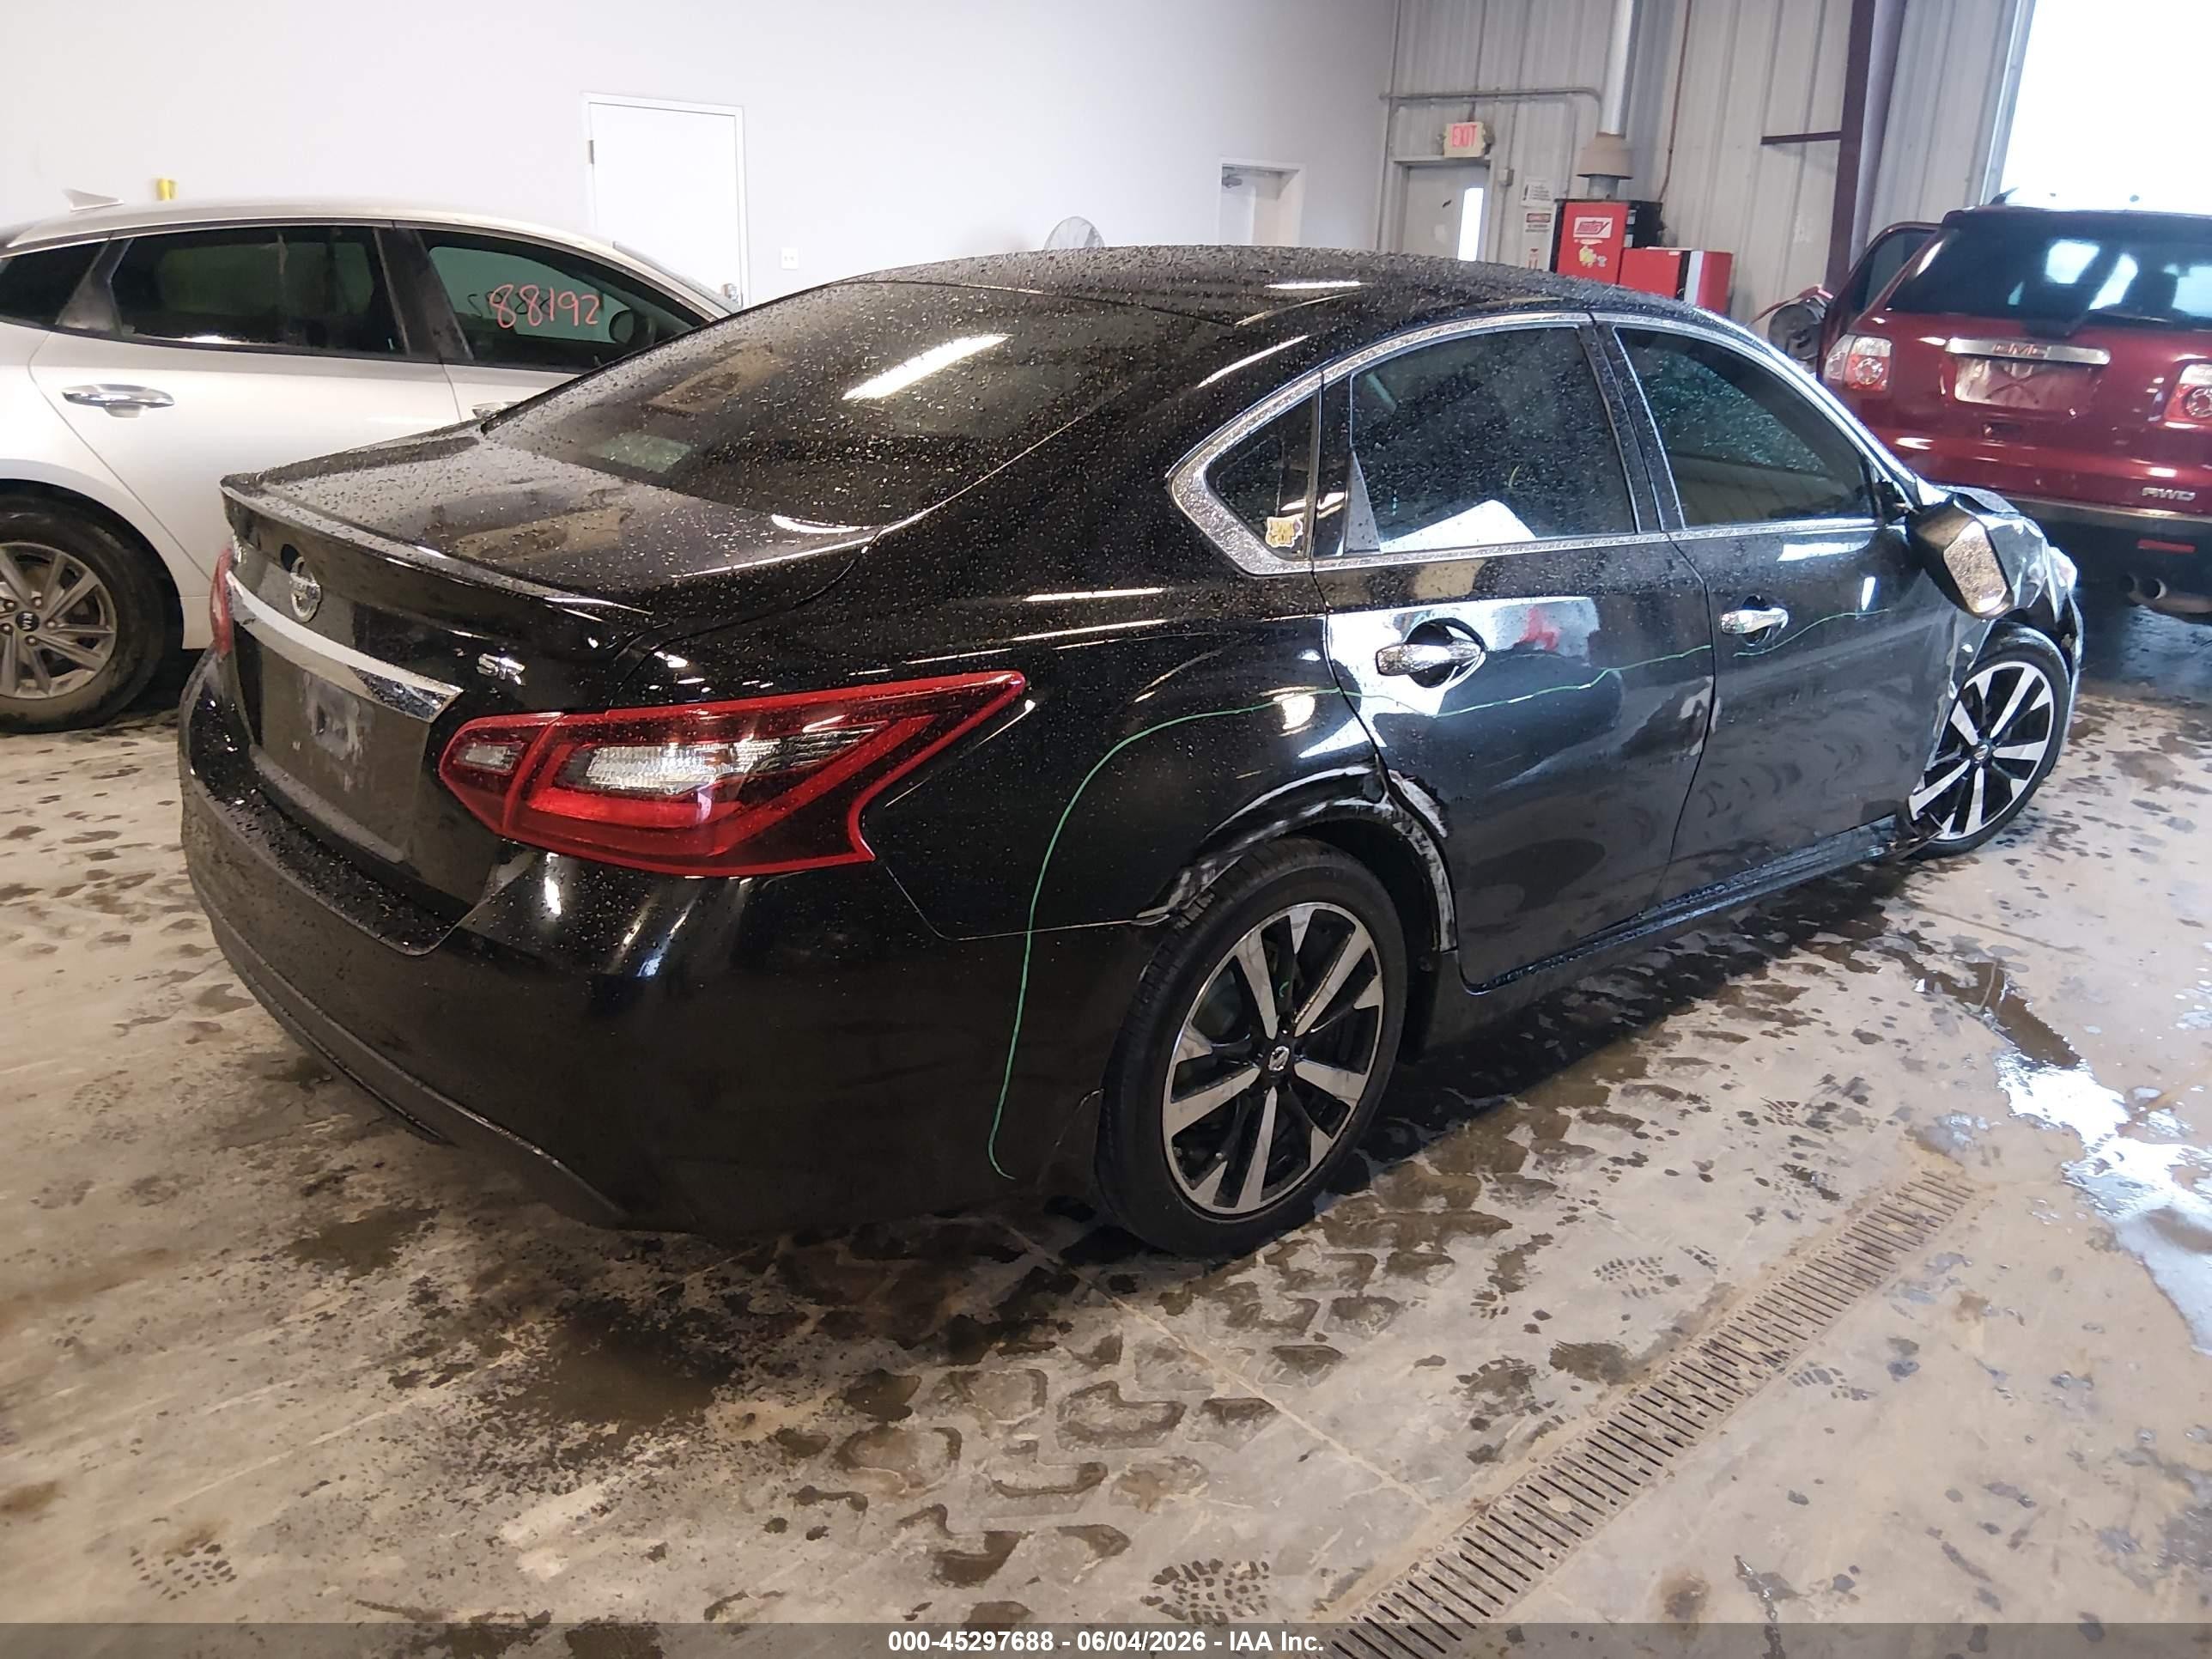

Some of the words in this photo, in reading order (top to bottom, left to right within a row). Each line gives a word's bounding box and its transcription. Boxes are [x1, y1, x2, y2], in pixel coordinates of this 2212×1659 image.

[1452, 124, 1477, 147] EXIT
[489, 283, 599, 328] 88192
[2142, 487, 2196, 501] AWD
[476, 653, 526, 685] SR
